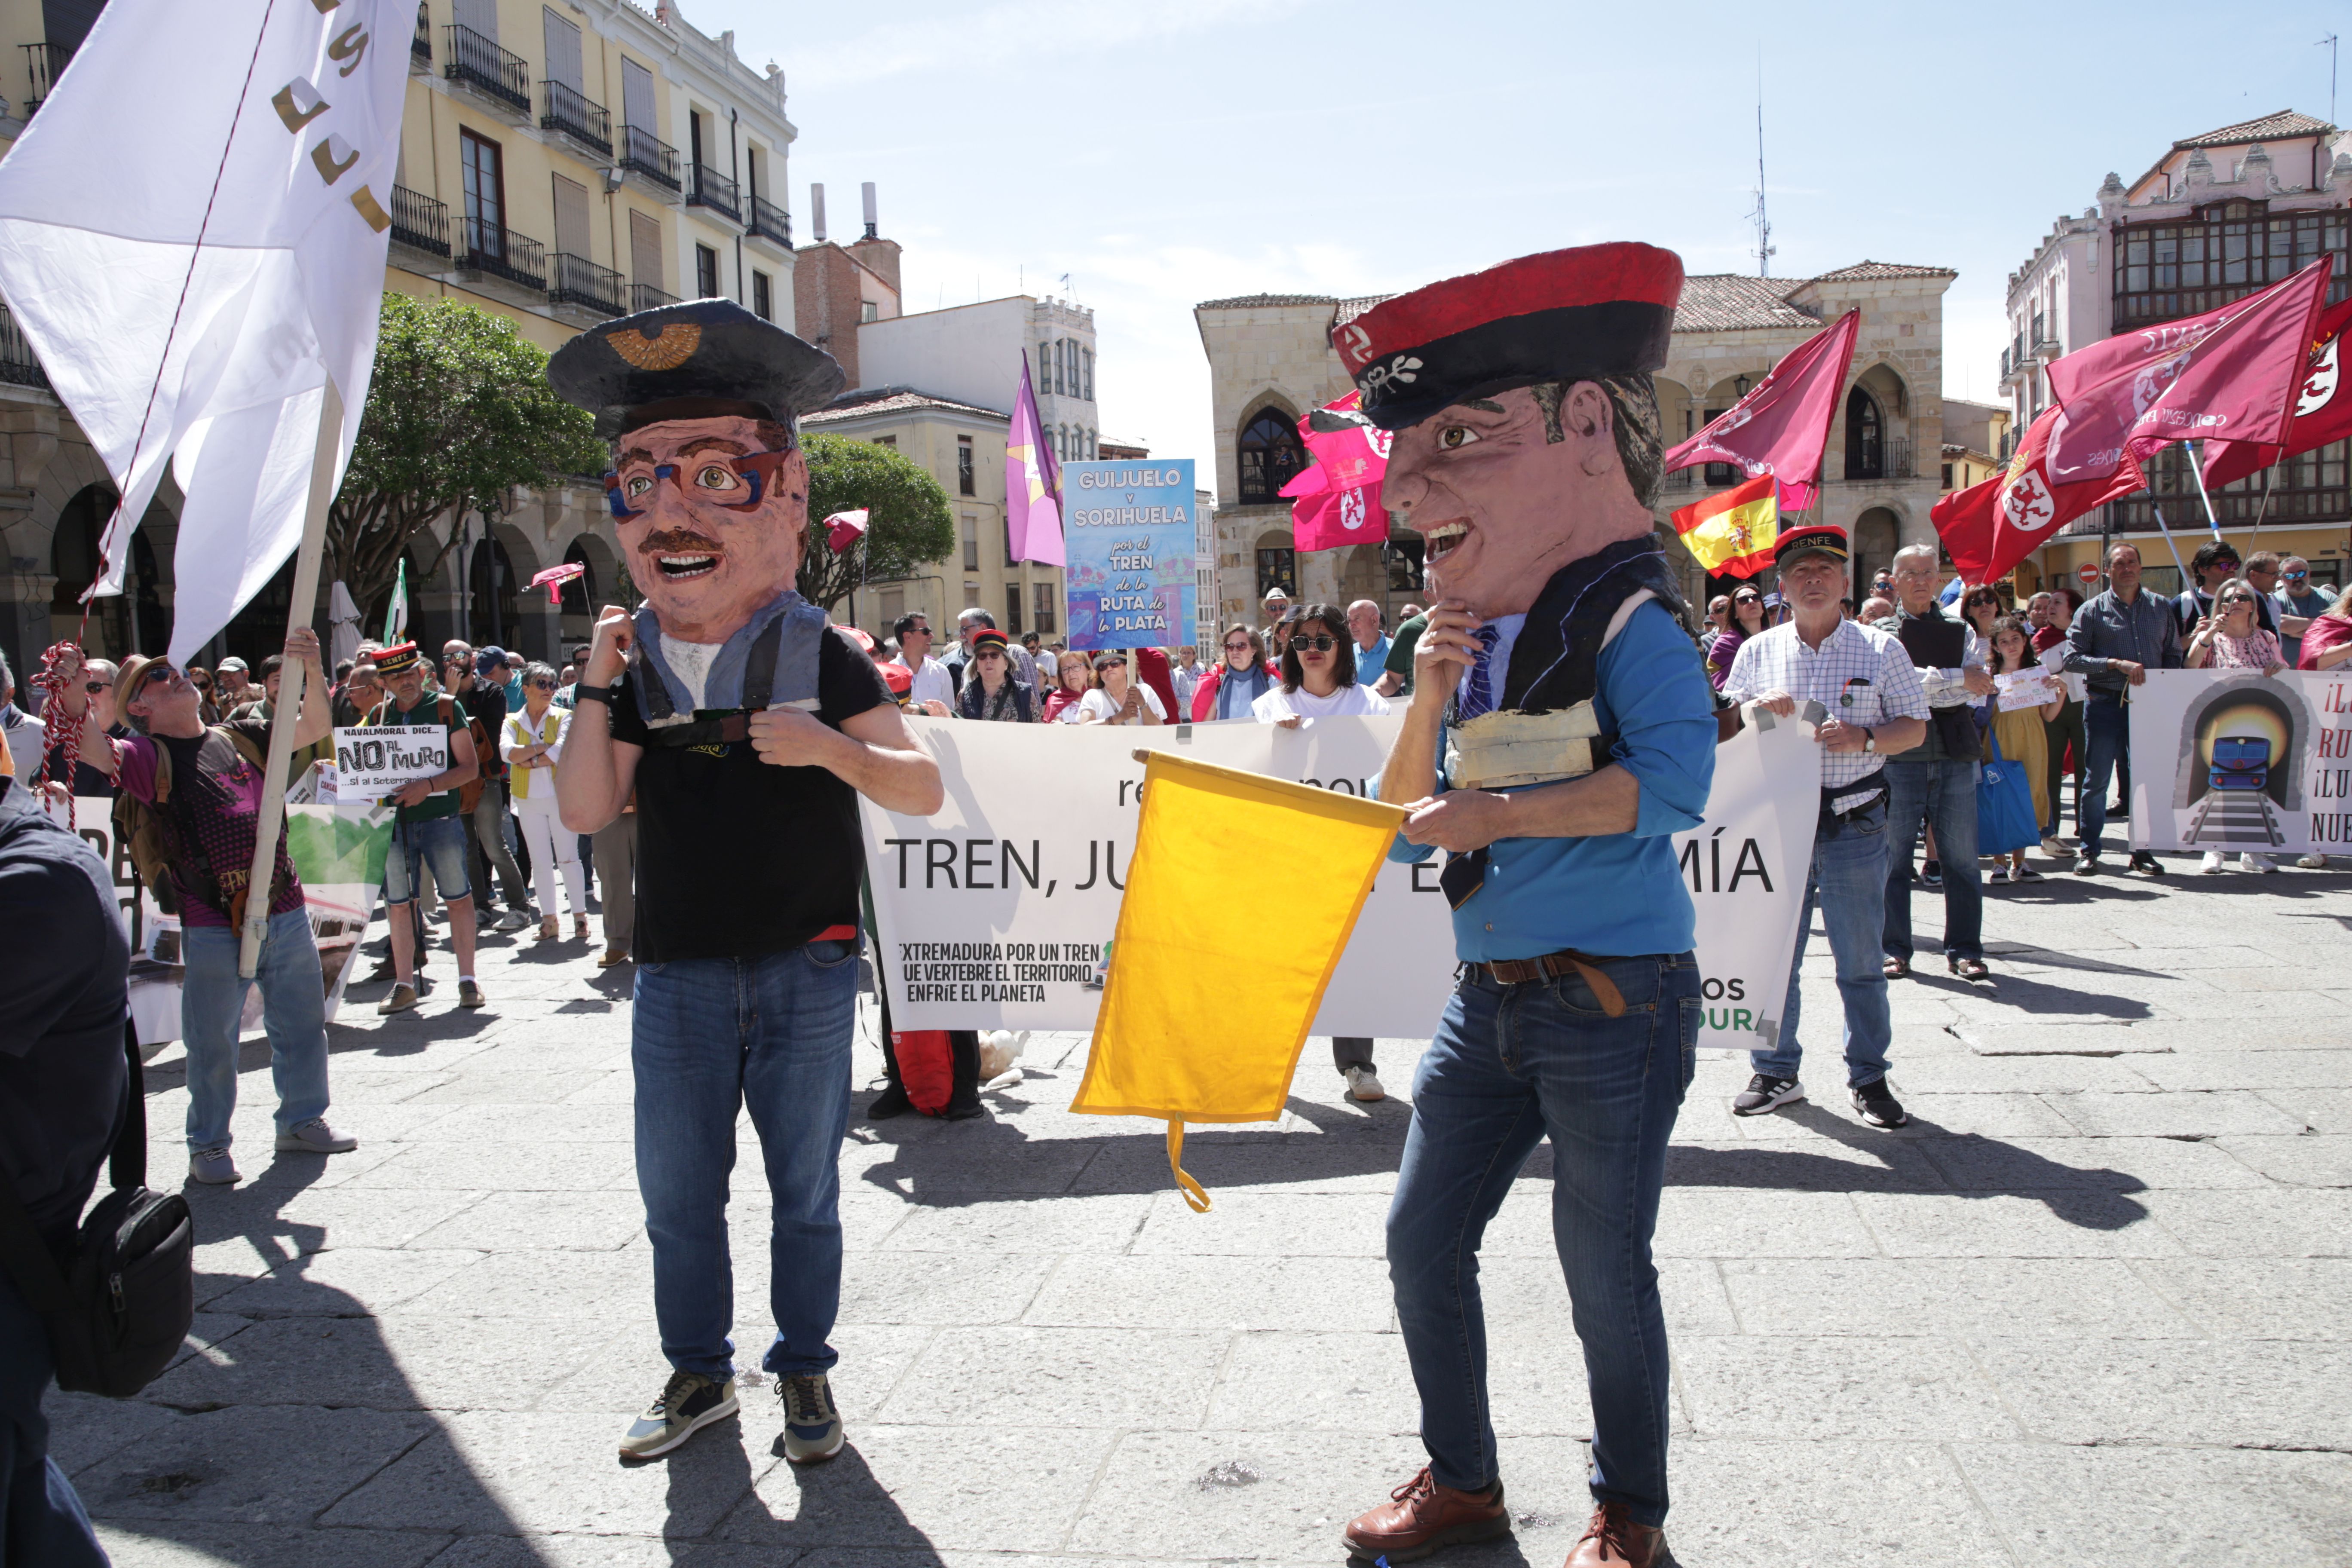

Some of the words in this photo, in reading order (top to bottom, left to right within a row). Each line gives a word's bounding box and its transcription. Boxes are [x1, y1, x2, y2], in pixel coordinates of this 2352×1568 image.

[1078, 469, 1182, 489] GUIJUELO
[1126, 493, 1134, 503] Y
[1074, 506, 1187, 527] SORIHUELA
[1111, 539, 1133, 556] por
[1137, 535, 1149, 549] el
[1792, 537, 1831, 550] RENFE
[1109, 555, 1153, 570] TREN
[1115, 577, 1131, 591] de
[1135, 576, 1148, 590] la
[1100, 596, 1145, 612] RUTA
[1148, 596, 1165, 609] de
[1098, 618, 1111, 632] la
[1115, 615, 1166, 631] PLATA
[382, 653, 408, 666] RENFE
[344, 728, 407, 736] NAVALMORAL
[338, 740, 385, 774] NO
[385, 741, 403, 753] AL
[392, 747, 446, 770] MURO
[885, 839, 1057, 898] TREN,
[899, 943, 1002, 961] XTREMADURA
[1006, 943, 1035, 961] POR
[1039, 944, 1059, 961] UN
[1063, 944, 1099, 962] TREN
[902, 964, 922, 982] UE
[924, 964, 992, 981] VERTEBRE
[995, 964, 1011, 981] EL
[1013, 964, 1092, 982] TERRITORIO
[962, 984, 977, 1002] EL
[981, 984, 1046, 1002] PLANETA
